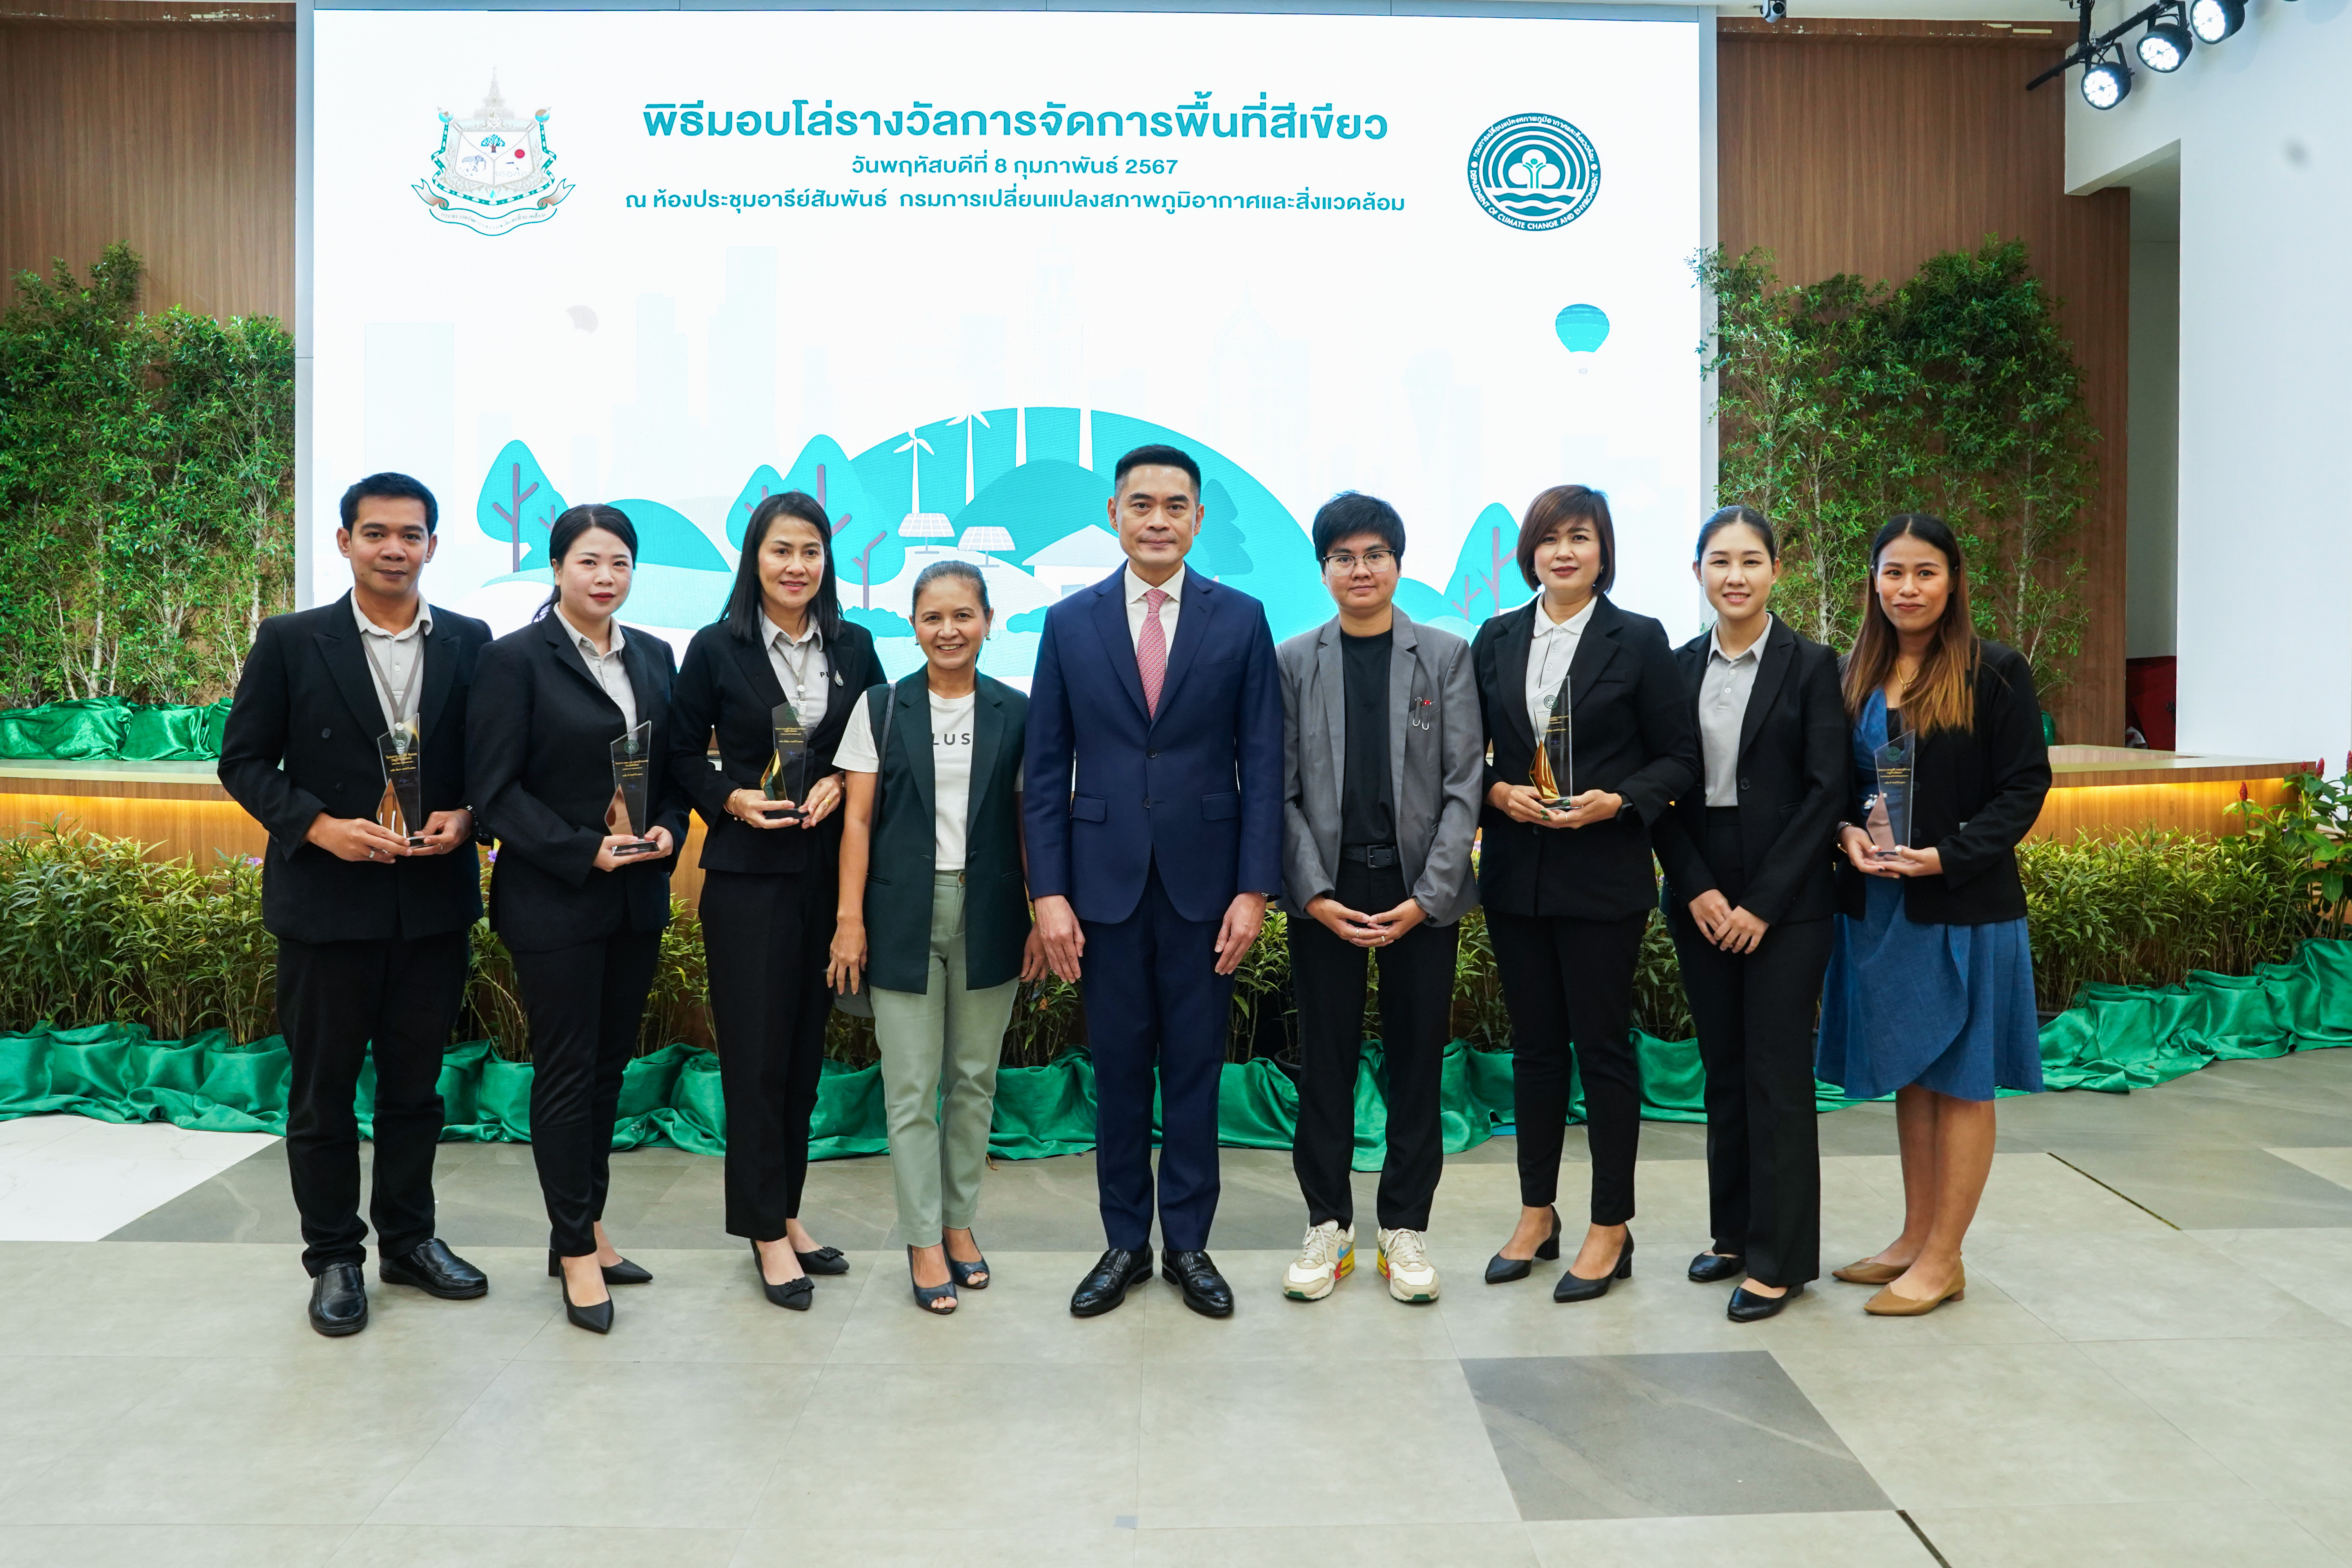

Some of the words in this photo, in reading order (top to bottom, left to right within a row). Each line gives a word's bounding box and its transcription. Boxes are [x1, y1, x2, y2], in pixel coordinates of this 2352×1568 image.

[643, 91, 1388, 140] พิธีมอบโล่รางวัลการจัดการพื้นที่สีเขียว
[852, 149, 987, 177] วันพฤหัสบดีที่
[995, 158, 1007, 173] 8
[1014, 155, 1118, 179] กุมภาพันธ์
[1125, 159, 1178, 174] 2567
[626, 194, 646, 208] ณ
[653, 188, 887, 214] ห้องประชุมอารีย์สัมพันธ์
[900, 183, 1405, 214] กรมการเปลี่ยนแปลงสภาพภูมิอากาศและสิ่งแวดล้อม
[1488, 206, 1498, 216] OF
[1497, 214, 1526, 229] CLIMATE
[1527, 221, 1559, 230] CHANGE
[1560, 213, 1575, 224] AND
